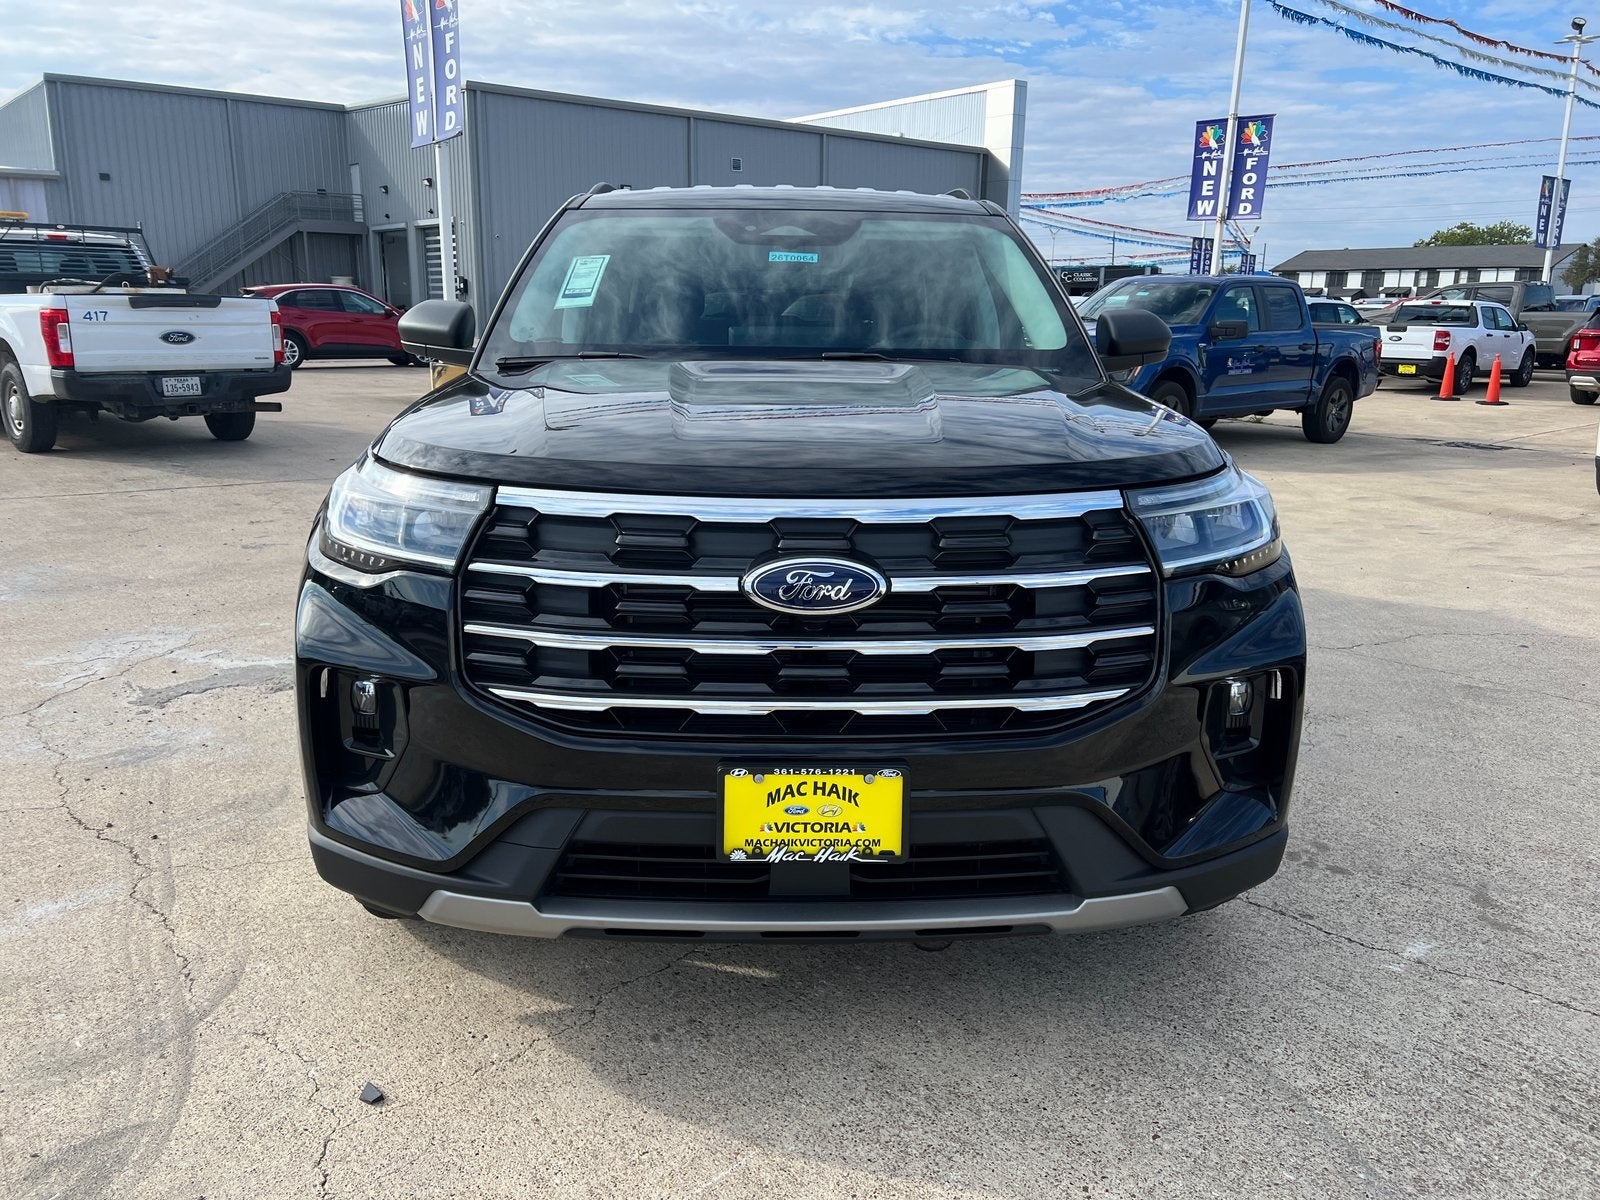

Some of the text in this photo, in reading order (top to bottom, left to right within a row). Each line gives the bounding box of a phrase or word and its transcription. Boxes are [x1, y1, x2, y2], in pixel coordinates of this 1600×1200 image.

[413, 42, 427, 136] NEW
[445, 32, 456, 130] FORD
[1197, 160, 1217, 215] NEW
[1238, 158, 1258, 214] FORD
[1537, 205, 1547, 244] NEW
[83, 311, 108, 321] 417
[778, 570, 853, 600] Ford
[766, 781, 860, 808] MAC HAIK
[744, 838, 881, 847] MACHAIKVICTORIA.COM
[774, 822, 852, 833] VICTORIA
[765, 846, 866, 863] Mac Haik
